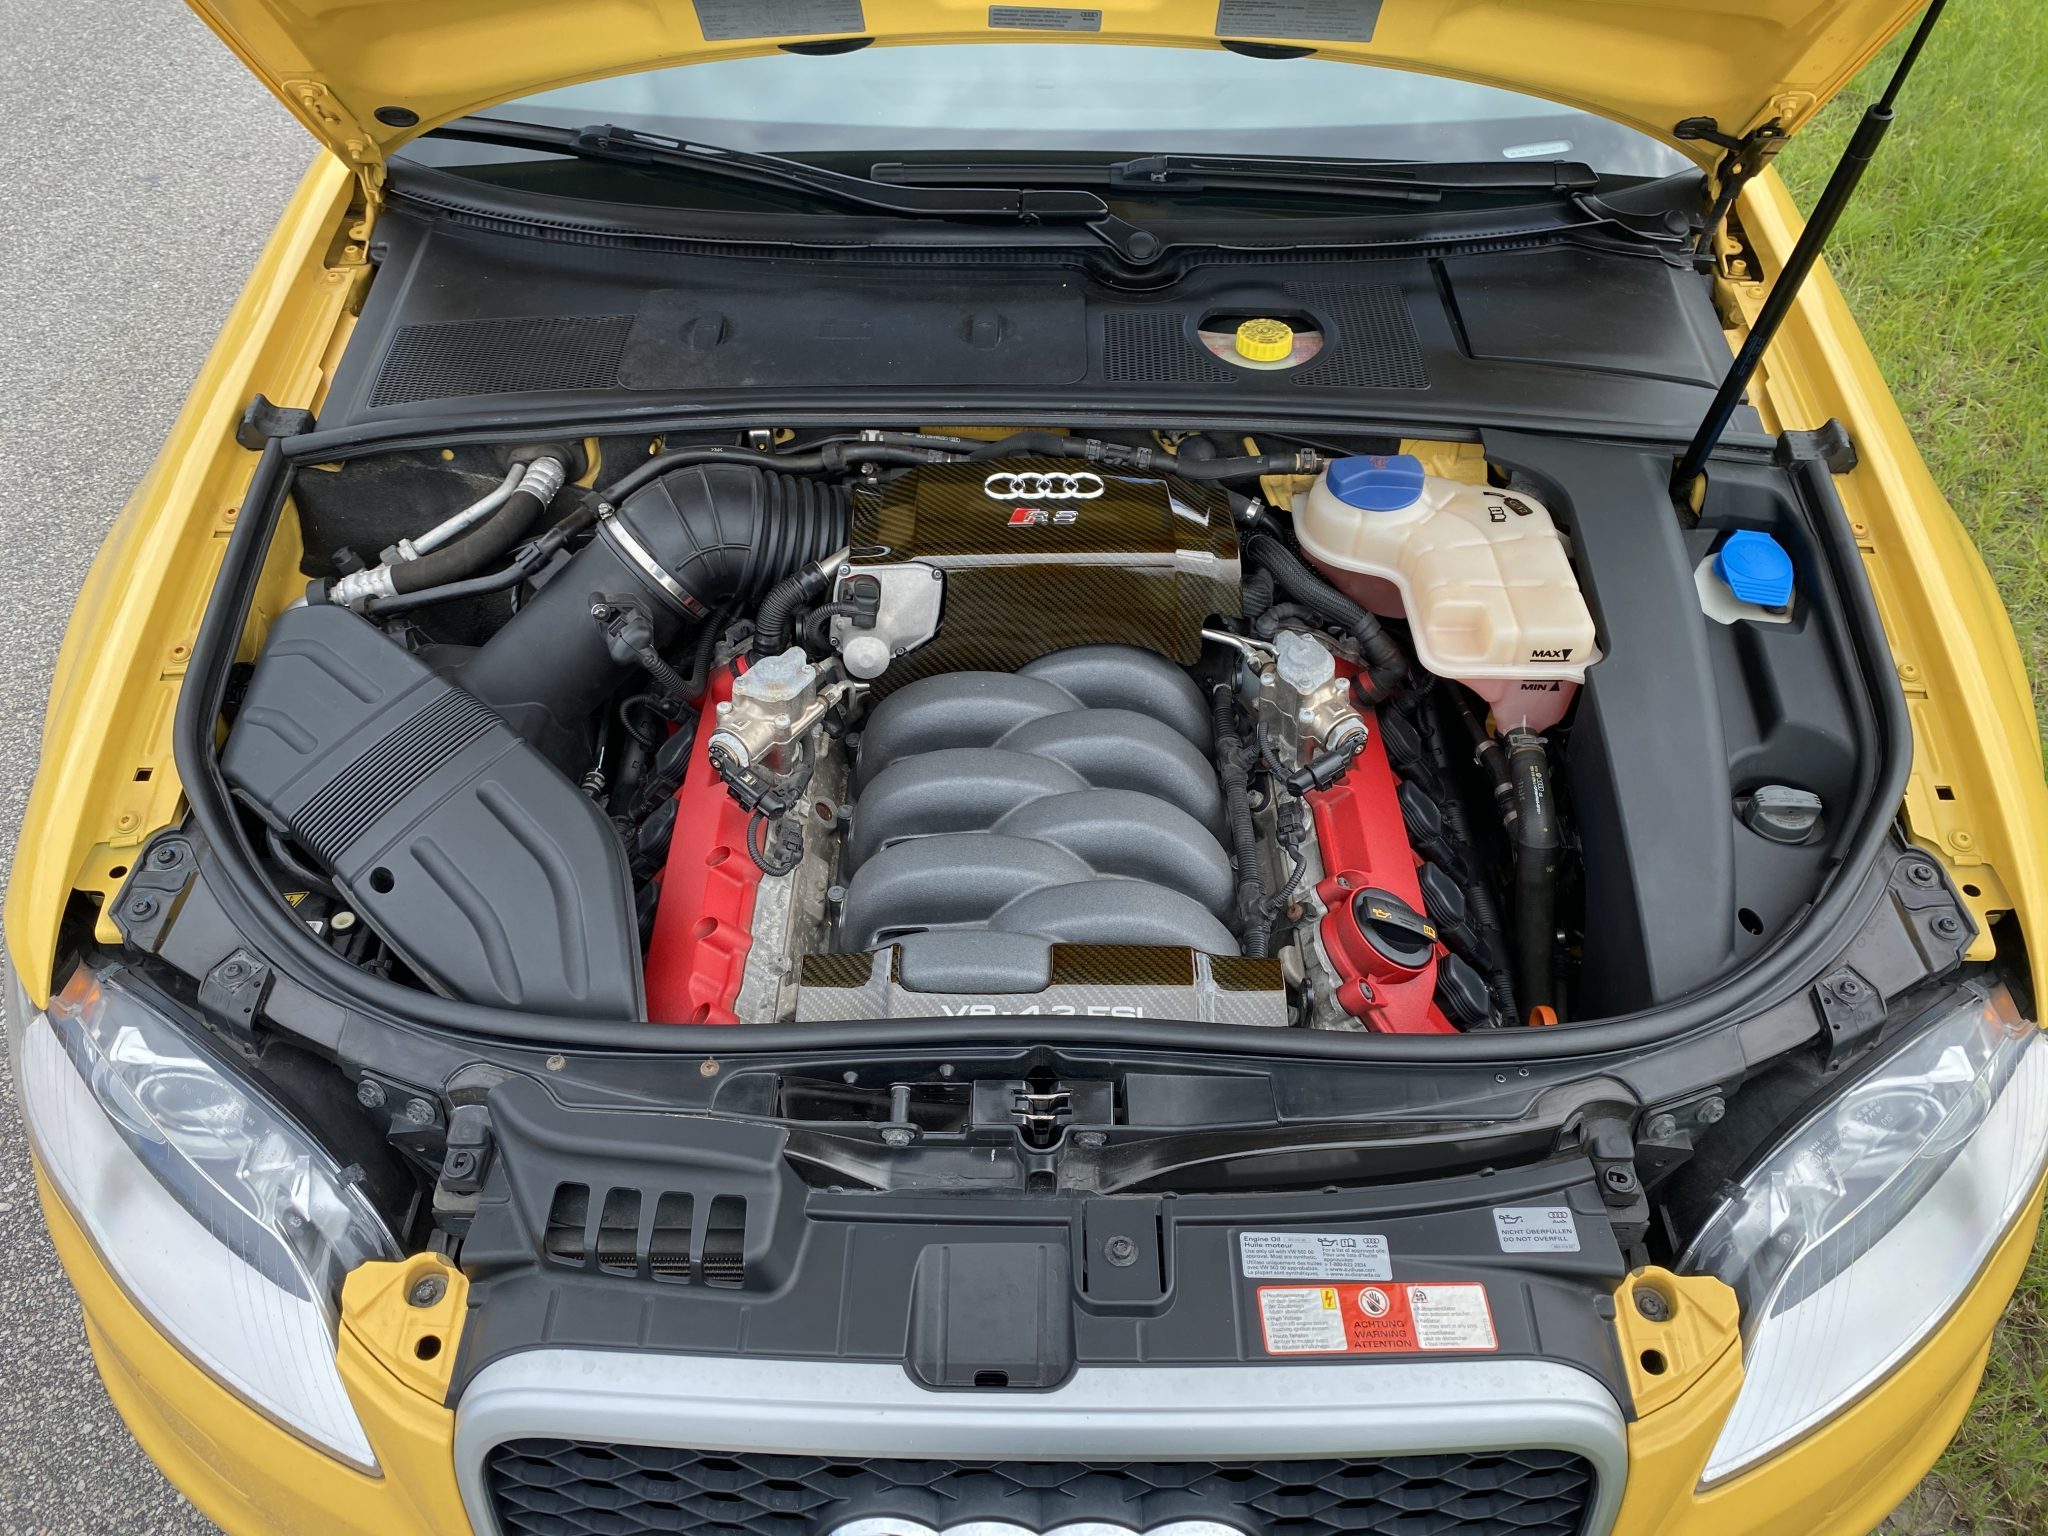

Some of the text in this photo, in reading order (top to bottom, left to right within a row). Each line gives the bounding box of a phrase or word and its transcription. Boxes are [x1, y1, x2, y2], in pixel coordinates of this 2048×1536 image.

[1531, 649, 1561, 658] MAX
[1520, 683, 1547, 691] MIN
[940, 1004, 996, 1017] V8
[1019, 1005, 1075, 1016] 42
[1087, 1005, 1143, 1018] FSI
[1243, 1235, 1269, 1243] Engine
[1353, 1320, 1405, 1329] ACHTUNG
[1353, 1329, 1407, 1338] WARNING
[1354, 1340, 1412, 1348] ATTENTION
